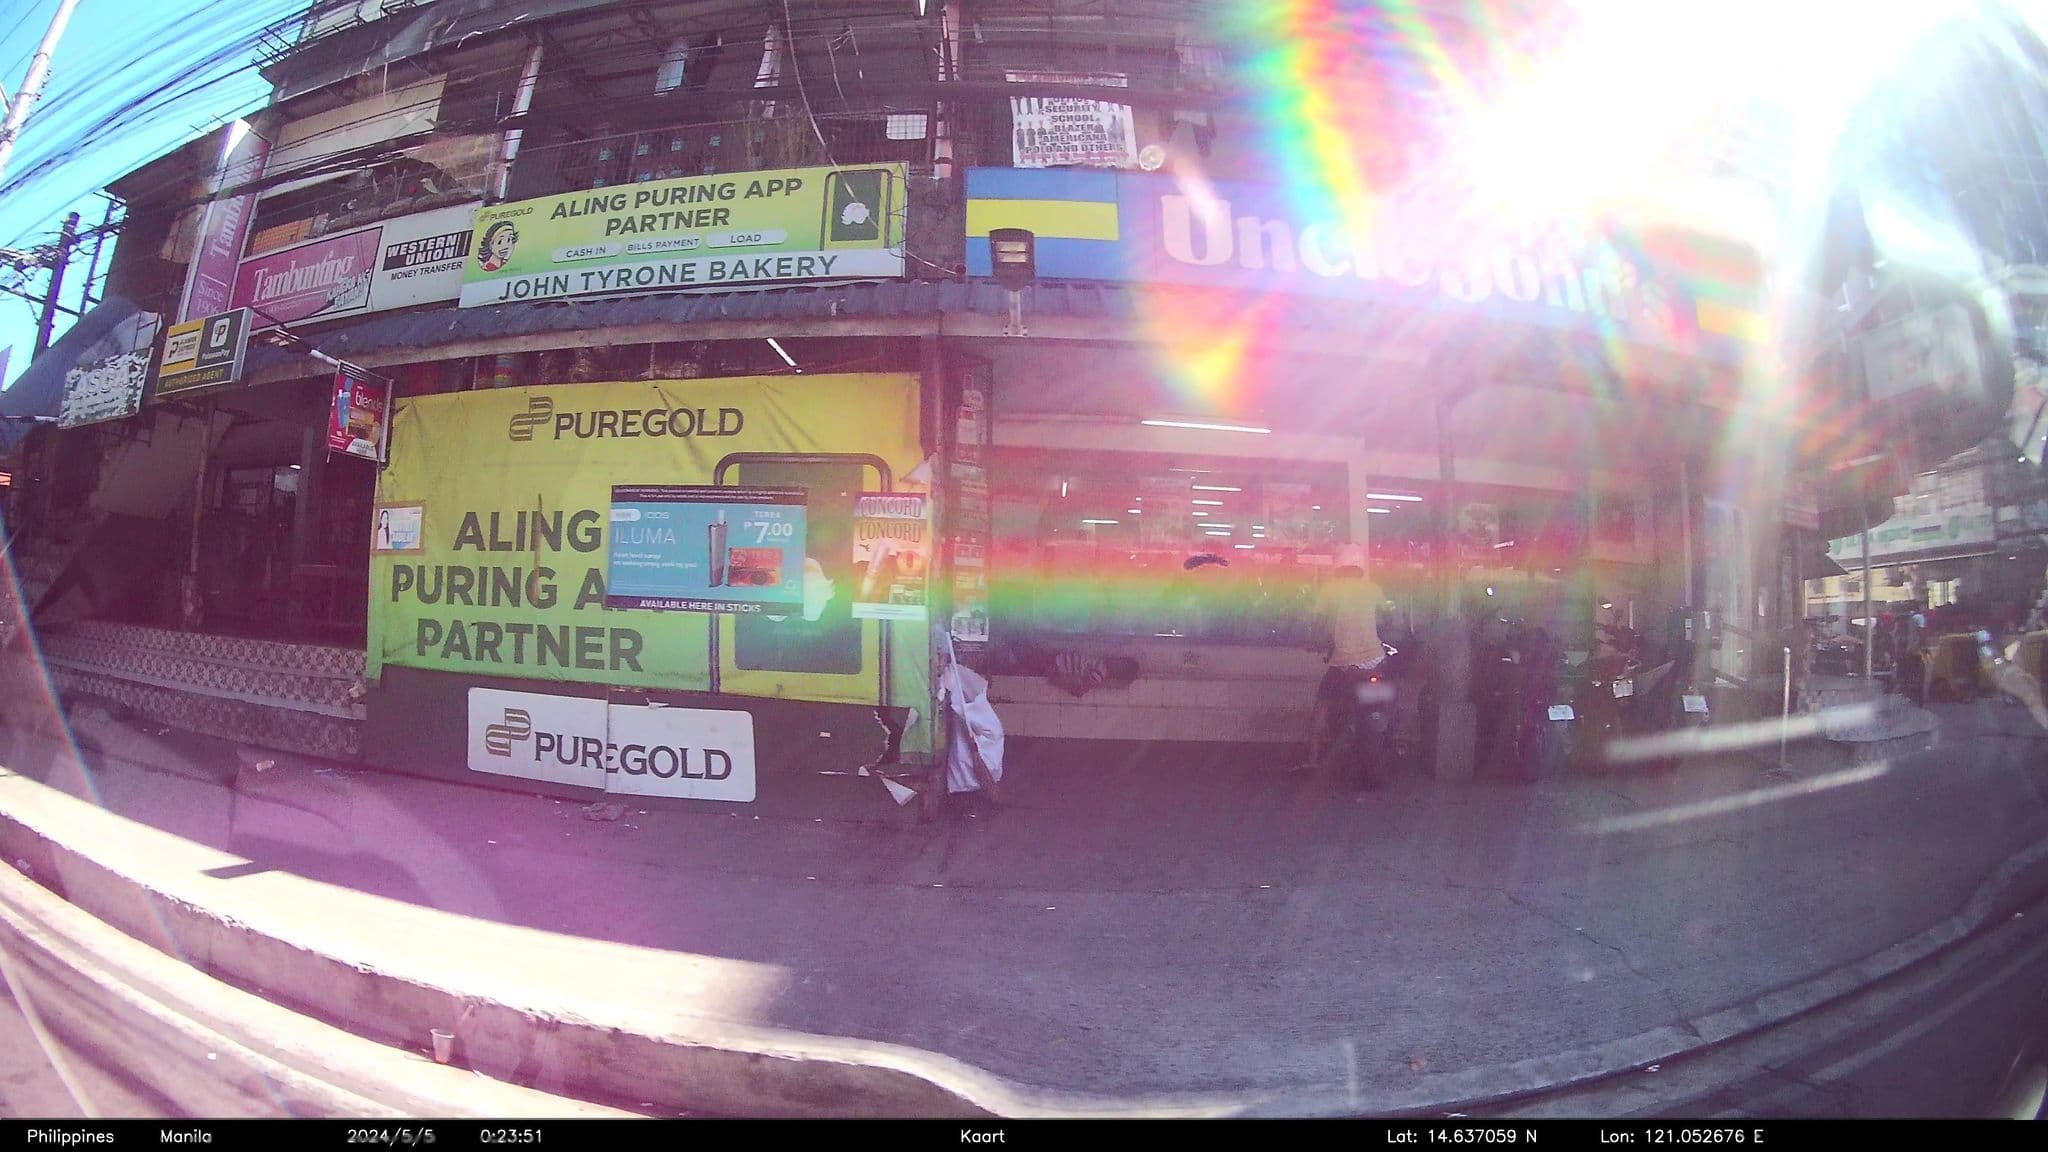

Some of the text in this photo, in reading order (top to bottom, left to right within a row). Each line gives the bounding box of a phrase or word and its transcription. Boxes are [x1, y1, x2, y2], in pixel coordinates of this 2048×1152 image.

[1051, 115, 1096, 123] SCHOOL
[1053, 124, 1095, 132] BLAZER
[1042, 133, 1108, 143] AMERICANA
[1026, 145, 1055, 154] POLO
[1056, 144, 1079, 153] AND
[549, 177, 803, 220] ALING PURING APP
[489, 207, 534, 220] PUREGOLD
[605, 207, 731, 237] PARTNER
[387, 234, 458, 258] WESTERN
[627, 237, 700, 252] BILLS PAYMENT
[730, 233, 762, 244] LOAD
[405, 246, 455, 266] UNION
[566, 246, 606, 258] CASH IN
[390, 260, 463, 282] MONEY TRANSFER
[499, 255, 838, 301] JOHN TYRONE BAKERY
[553, 407, 745, 440] PUREGOLD
[452, 509, 603, 553] ALING
[614, 527, 677, 545] ILUMA
[859, 520, 921, 543] CONCORD
[391, 564, 558, 610] PURING
[639, 599, 762, 613] AVAILABLE HERE IN STICKS
[416, 617, 644, 673] PARTNER
[533, 730, 732, 781] PUREGOLD
